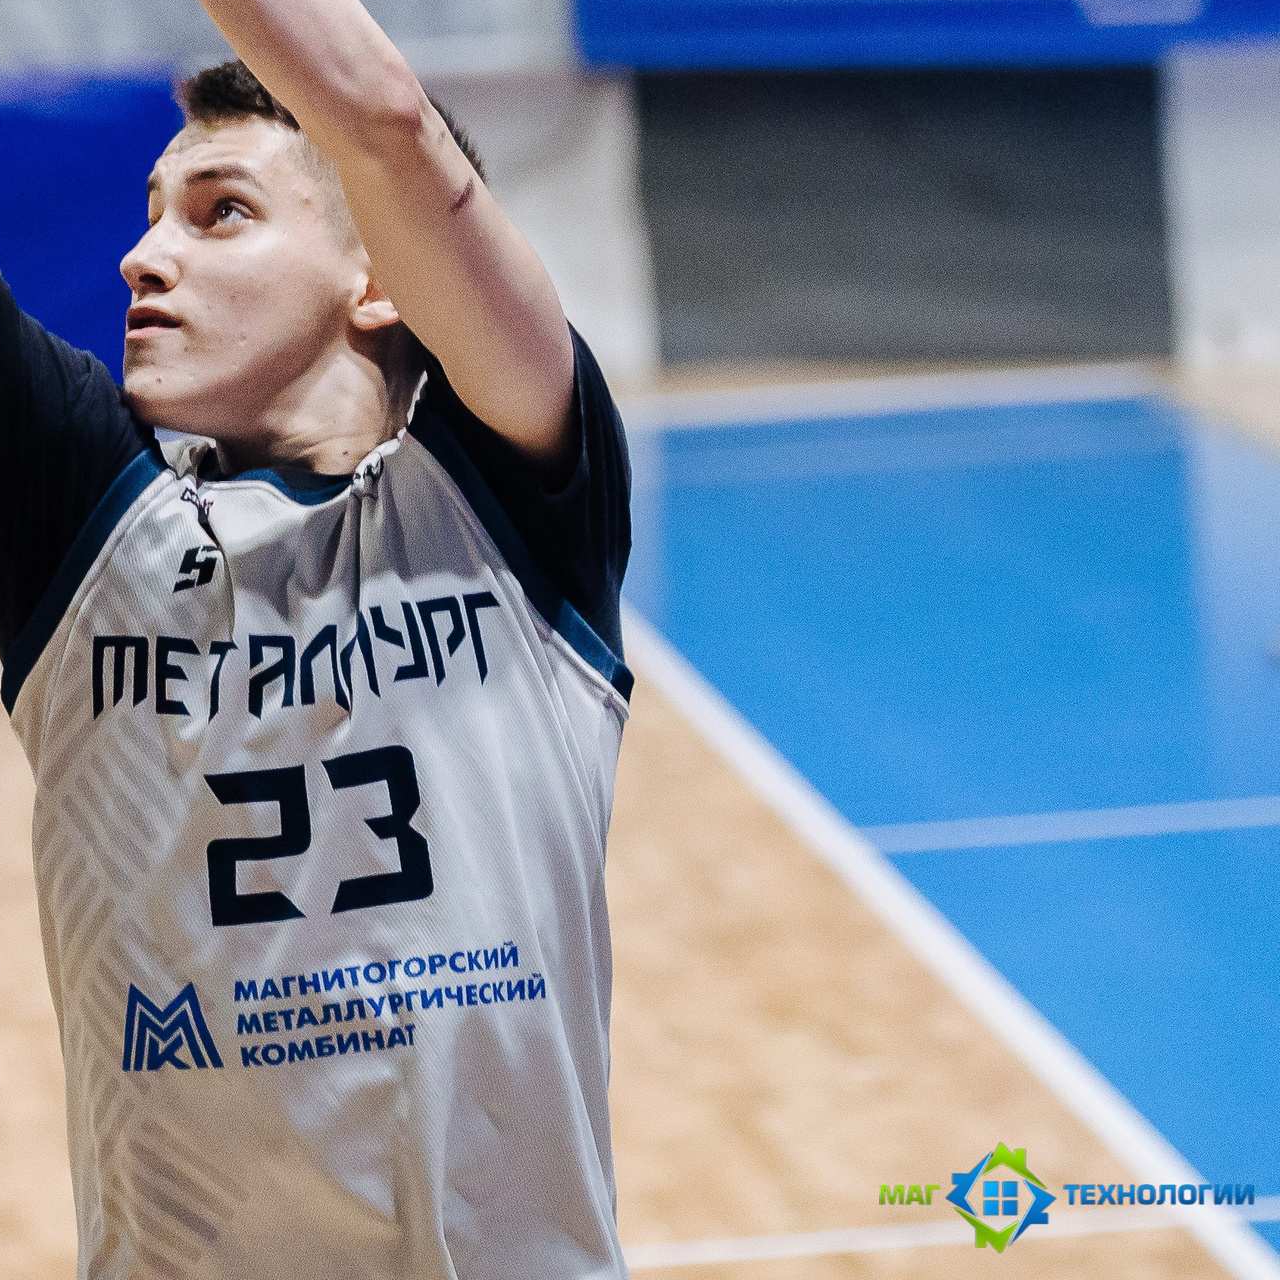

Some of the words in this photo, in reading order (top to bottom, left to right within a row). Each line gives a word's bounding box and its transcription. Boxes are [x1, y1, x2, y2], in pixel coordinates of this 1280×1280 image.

[93, 591, 500, 724] МЕТАЛЛУРГ
[204, 744, 434, 927] 23
[233, 941, 519, 1002] МАГНИТОГОРСКИЙ
[237, 973, 547, 1035] МЕТАЛЛУРГИЧЕСКИЙ
[240, 1024, 416, 1068] КОМБИНАТ
